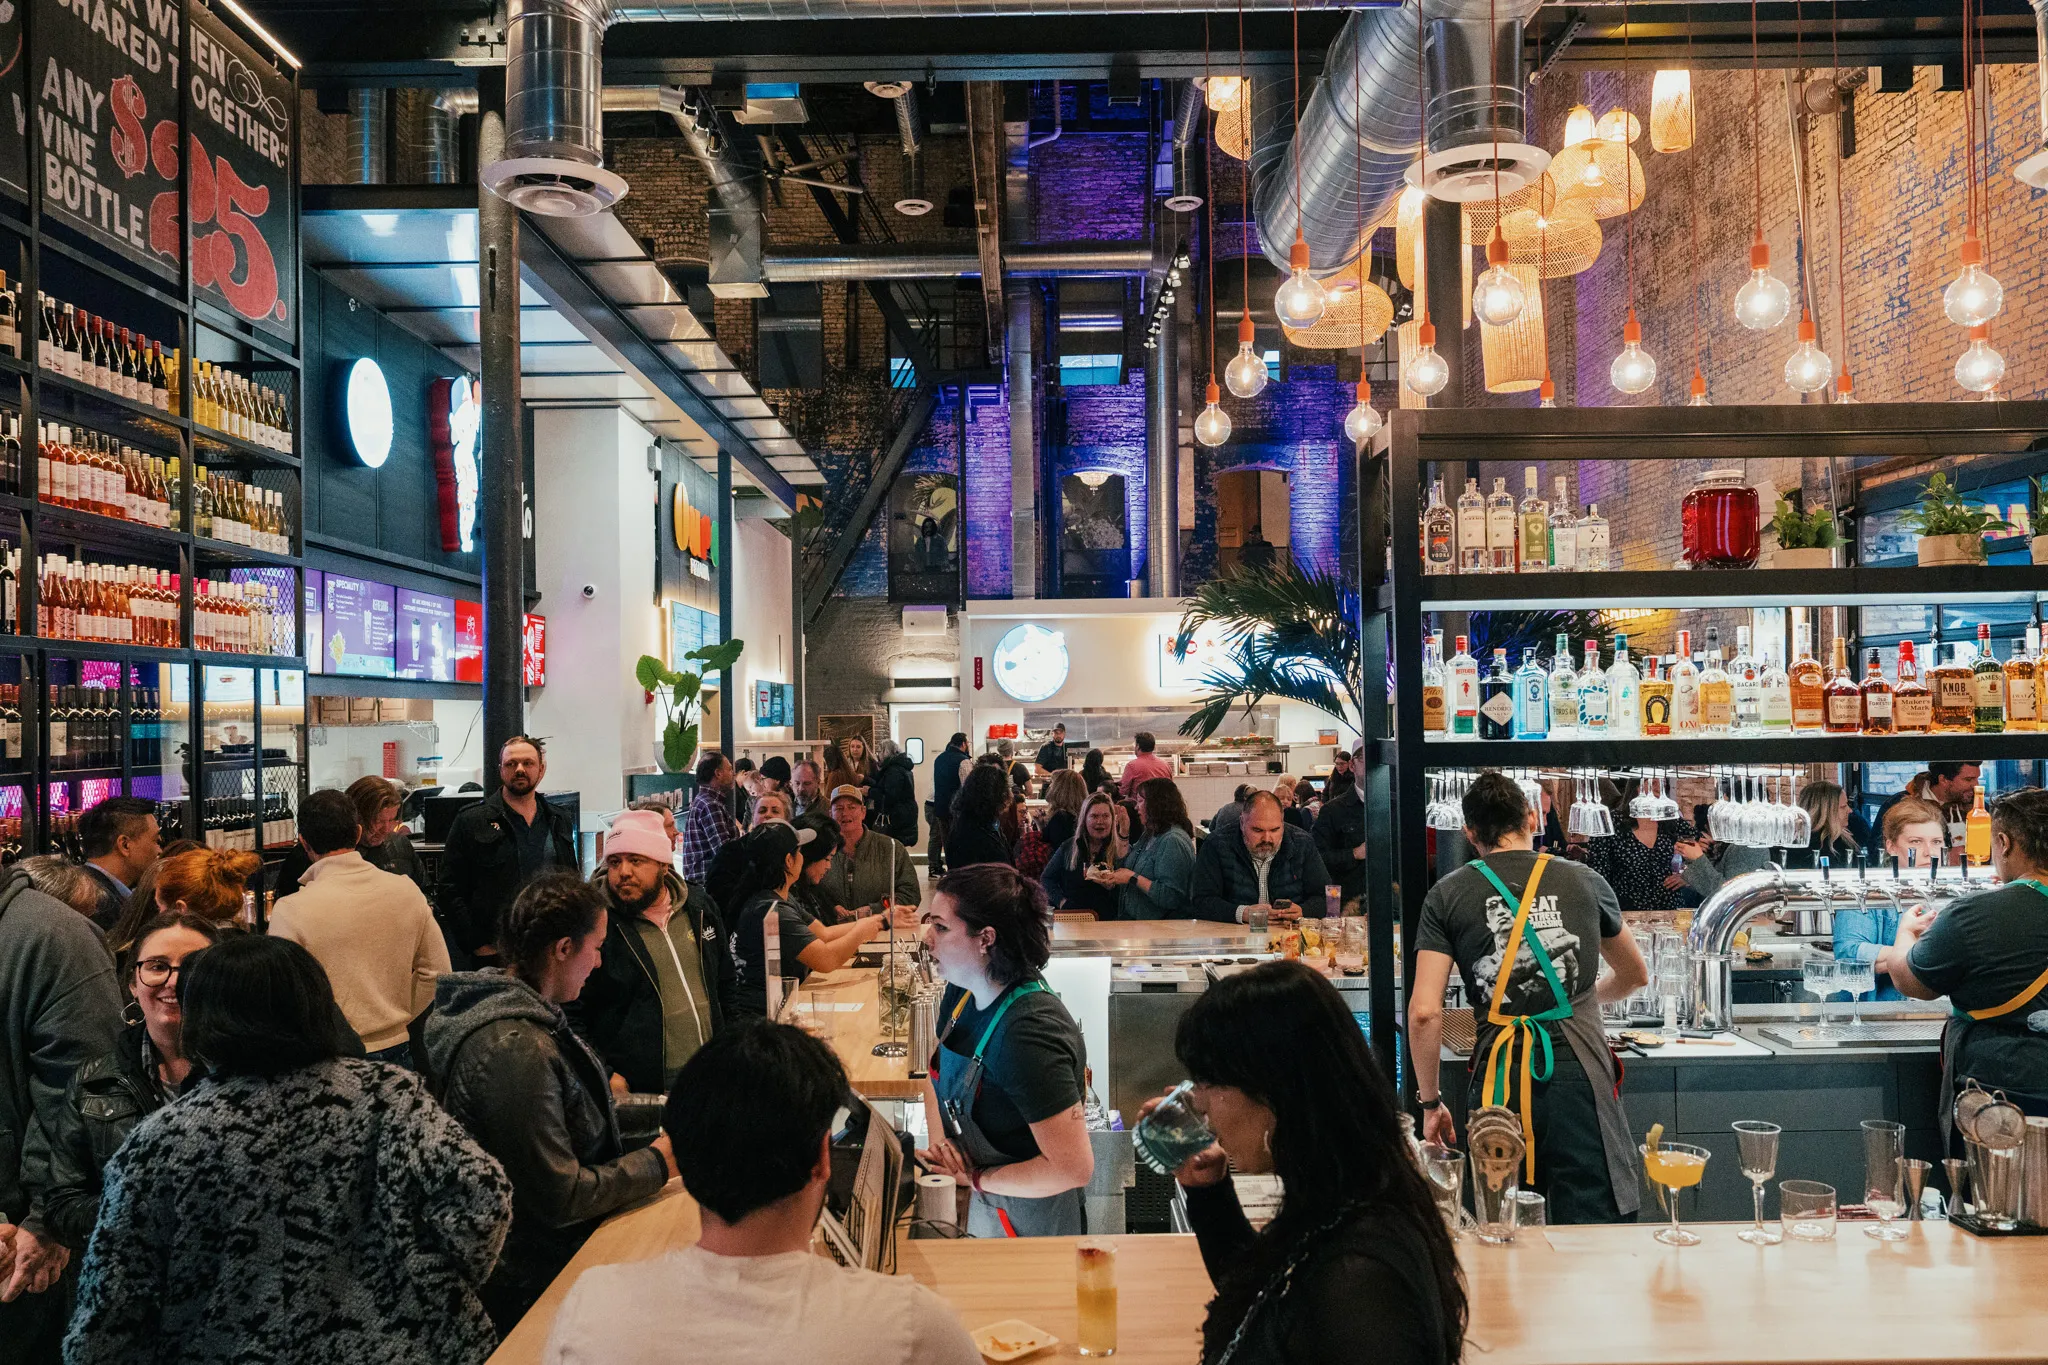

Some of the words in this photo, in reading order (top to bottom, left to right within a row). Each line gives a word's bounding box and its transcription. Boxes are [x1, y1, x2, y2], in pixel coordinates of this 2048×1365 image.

[57, 0, 161, 74] HARED
[42, 56, 105, 134] ANY
[45, 152, 146, 250] BOTTLE
[1943, 682, 1966, 692] KNOB
[1528, 911, 1562, 922] STREET
[1530, 895, 1559, 912] EAT
